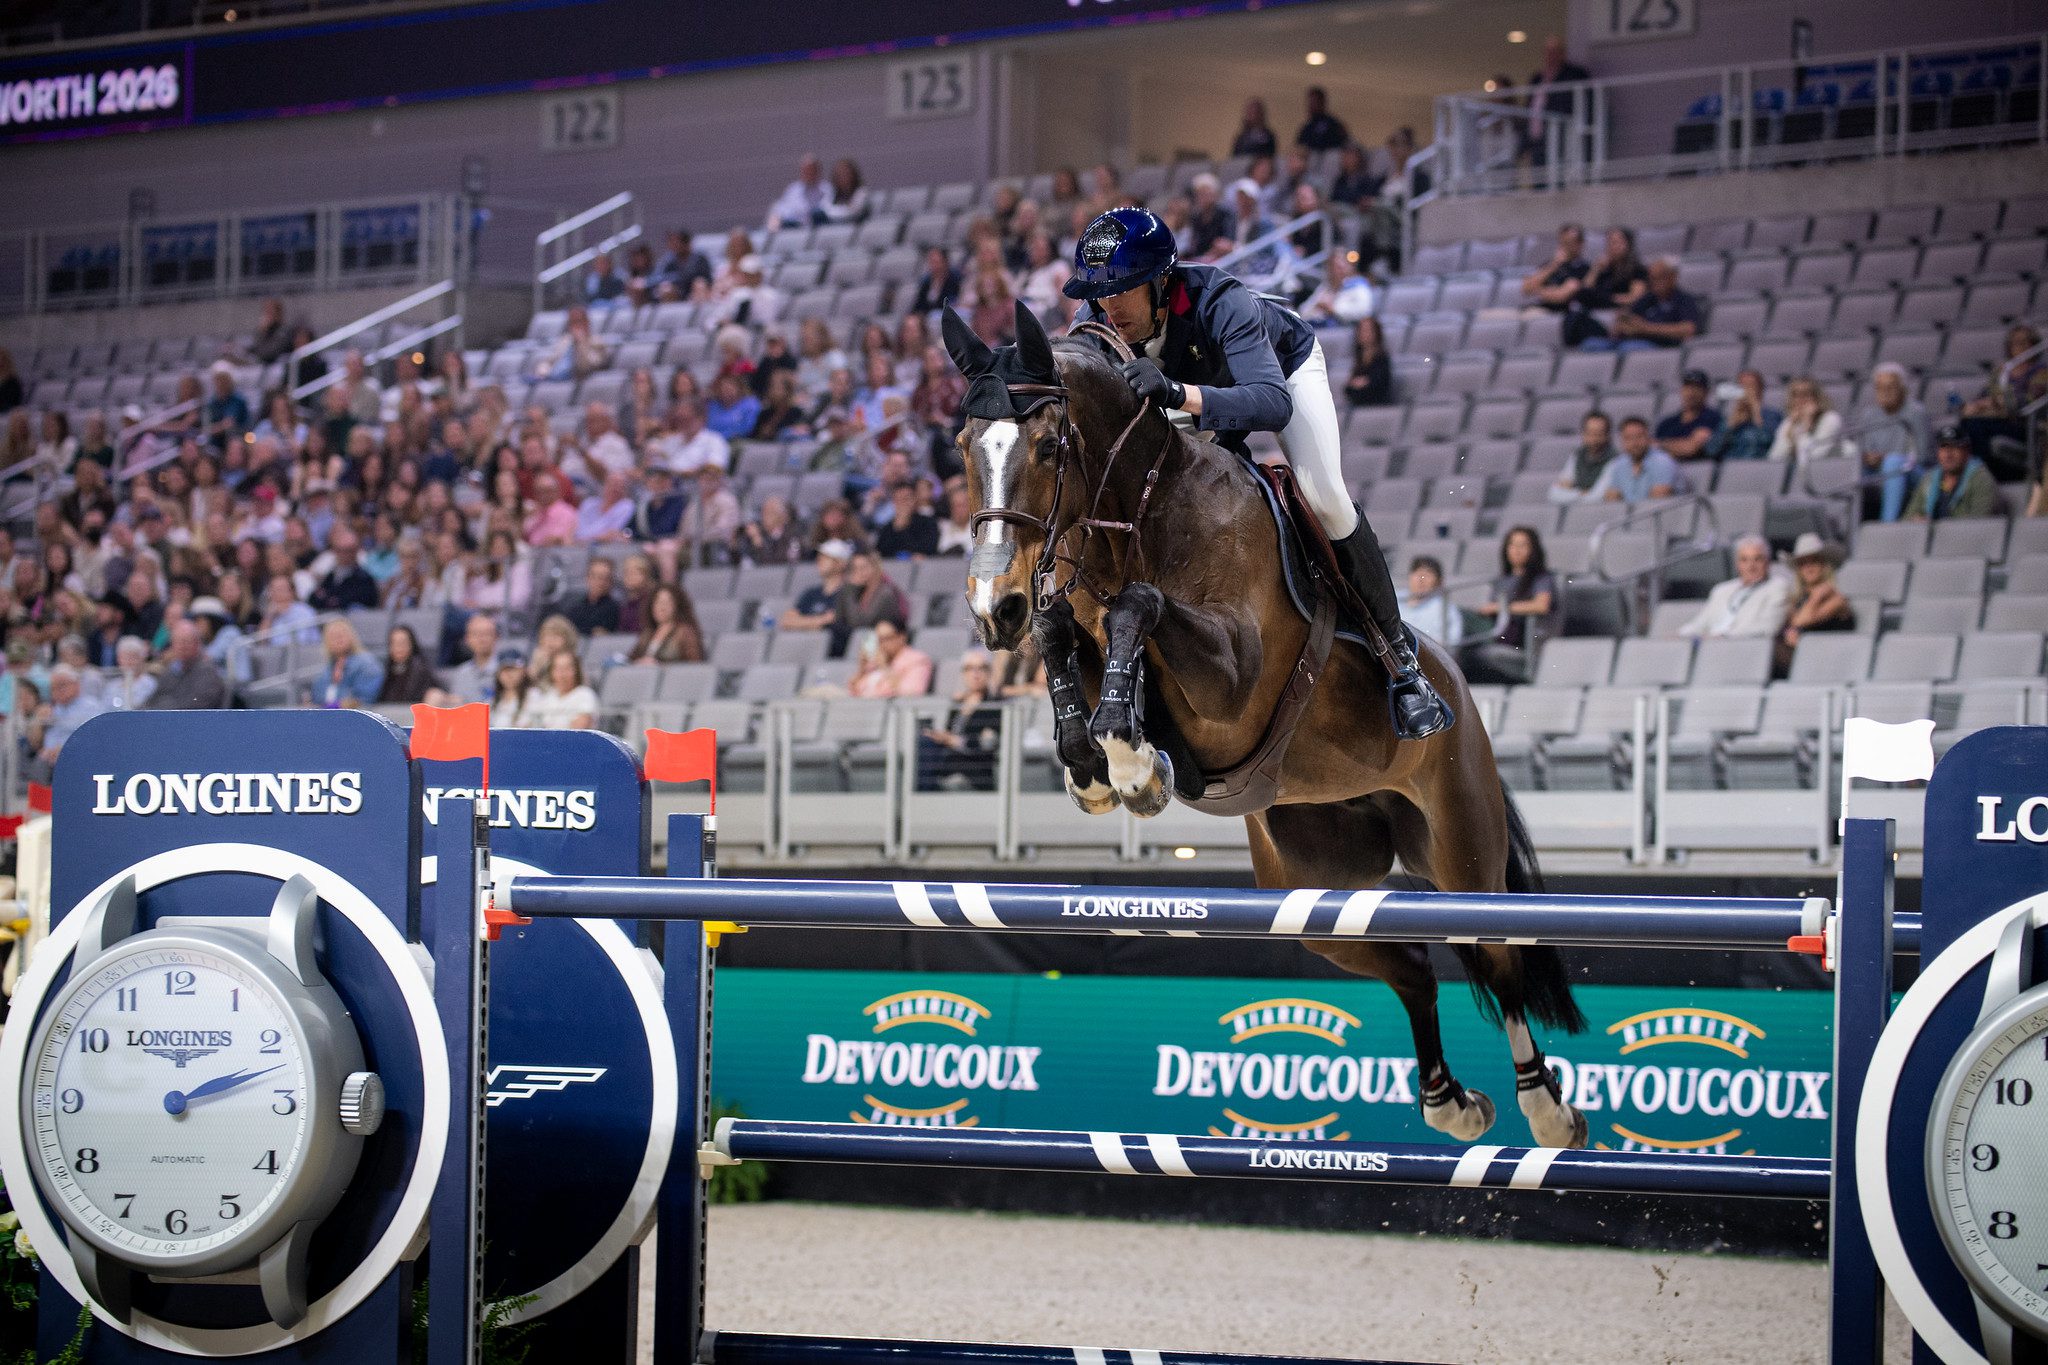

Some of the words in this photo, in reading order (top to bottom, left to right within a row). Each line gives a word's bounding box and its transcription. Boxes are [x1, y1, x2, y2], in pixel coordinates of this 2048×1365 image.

[97, 63, 178, 114] 2026
[902, 64, 961, 111] 123
[554, 102, 608, 142] 122
[92, 772, 363, 815] LONGINES
[1061, 896, 1209, 919] LONGINES
[164, 971, 196, 995] 12
[116, 987, 138, 1012] 11
[231, 988, 239, 1012] 1
[79, 1028, 109, 1053] 10
[127, 1030, 232, 1047] LONGINES
[260, 1029, 281, 1053] 2
[801, 1033, 1042, 1091] DEVOUCOUX
[1152, 1044, 1418, 1104] DEVOUCOUX
[61, 1088, 84, 1114] 9
[272, 1089, 297, 1115] 3
[1994, 1078, 2033, 1106] 10
[75, 1148, 99, 1173] 8
[151, 1155, 205, 1164] AUTOMATIC
[252, 1149, 280, 1175] 4
[1249, 1149, 1389, 1172] LONGINES
[1971, 1144, 2000, 1172] 9
[114, 1193, 137, 1218] 7
[219, 1193, 241, 1219] 5
[165, 1209, 188, 1235] 6
[1988, 1211, 2019, 1239] 8
